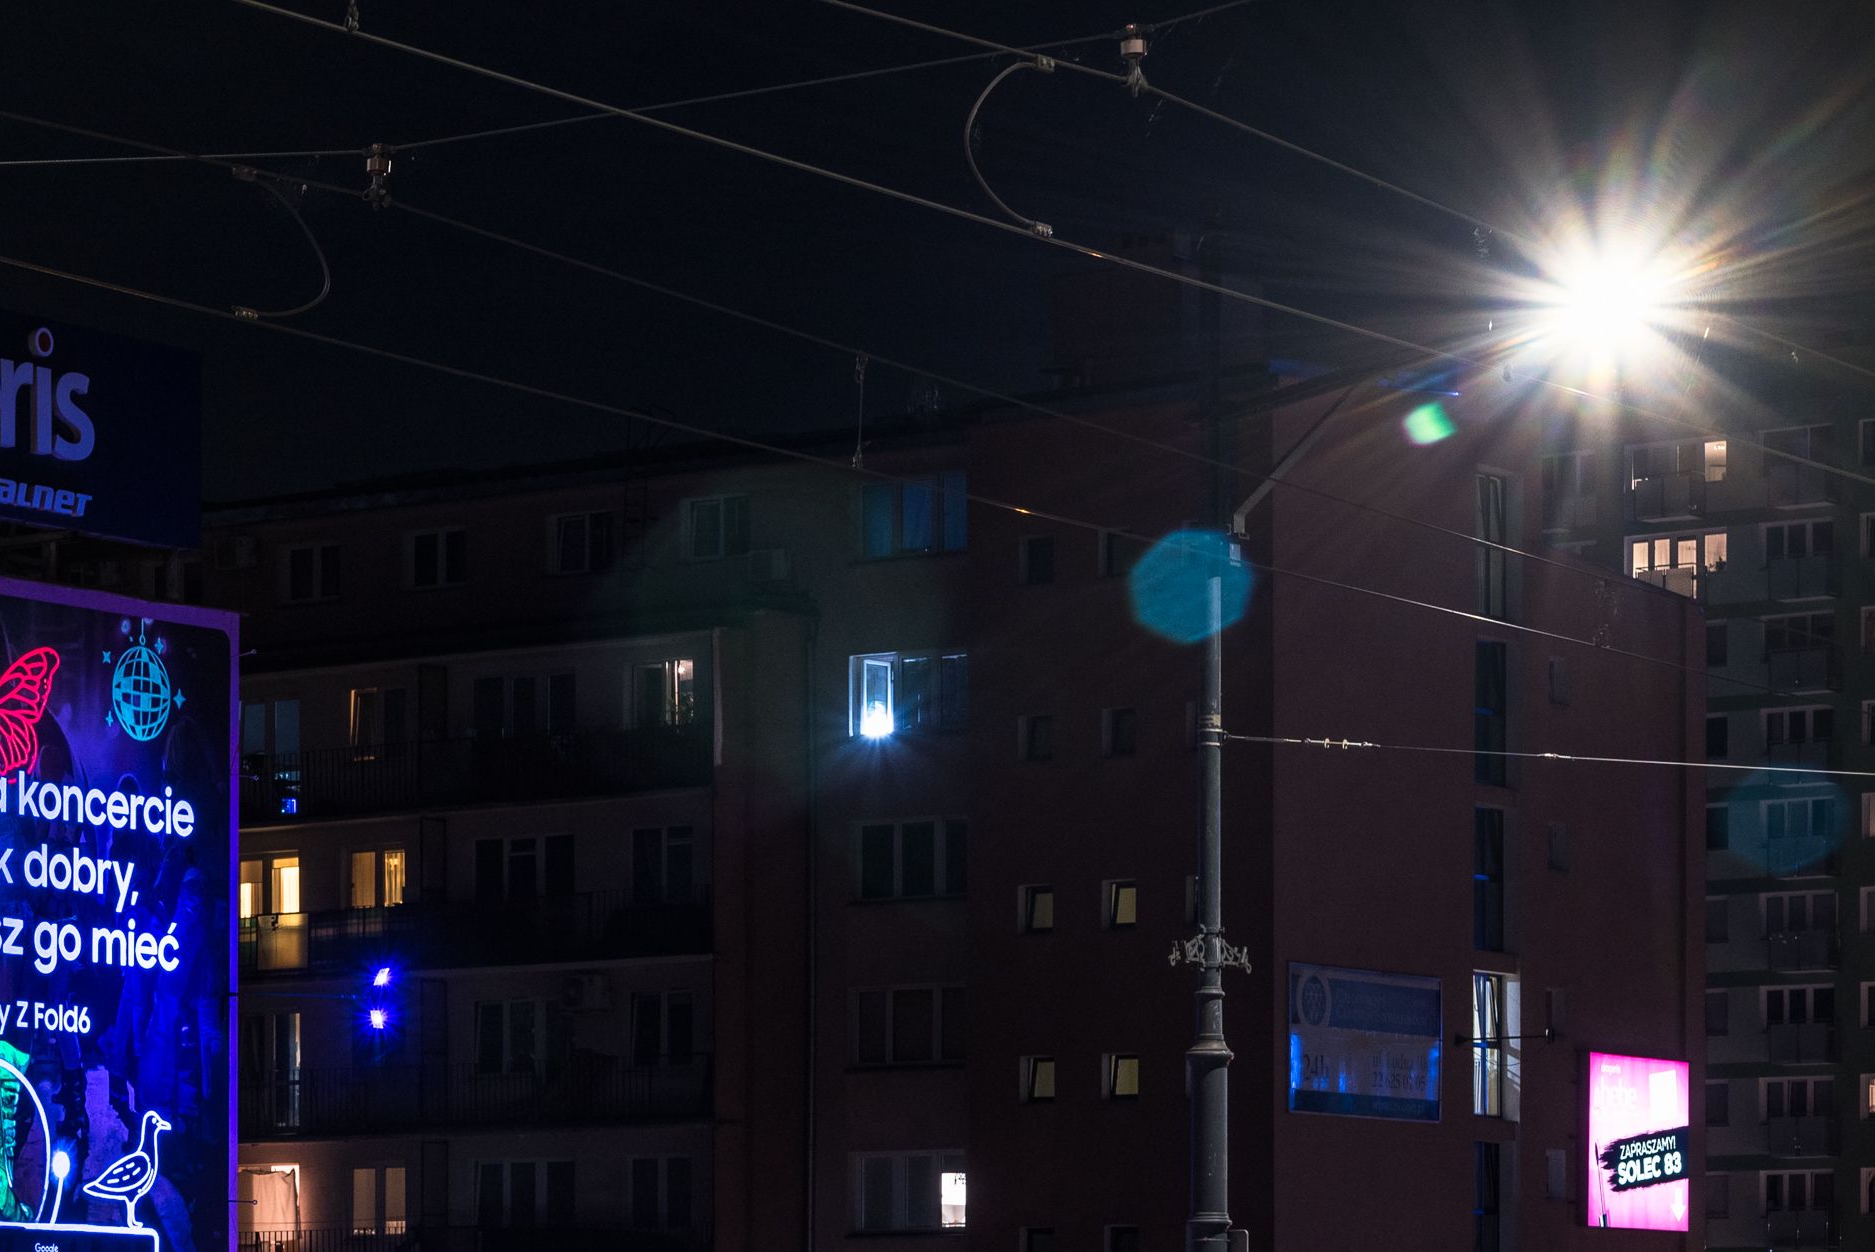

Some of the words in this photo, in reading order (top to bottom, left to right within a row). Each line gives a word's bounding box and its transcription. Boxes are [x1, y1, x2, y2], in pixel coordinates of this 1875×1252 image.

[18, 770, 195, 837] koncercie
[23, 843, 140, 914] dobry,
[34, 918, 82, 975] go
[91, 918, 180, 973] mieć
[16, 1000, 29, 1028] Z
[34, 1001, 91, 1034] Fold6
[1617, 1155, 1662, 1185] SOLEC
[1664, 1151, 1682, 1175] 83
[1619, 1135, 1676, 1160] ZAPRASZAMY!
